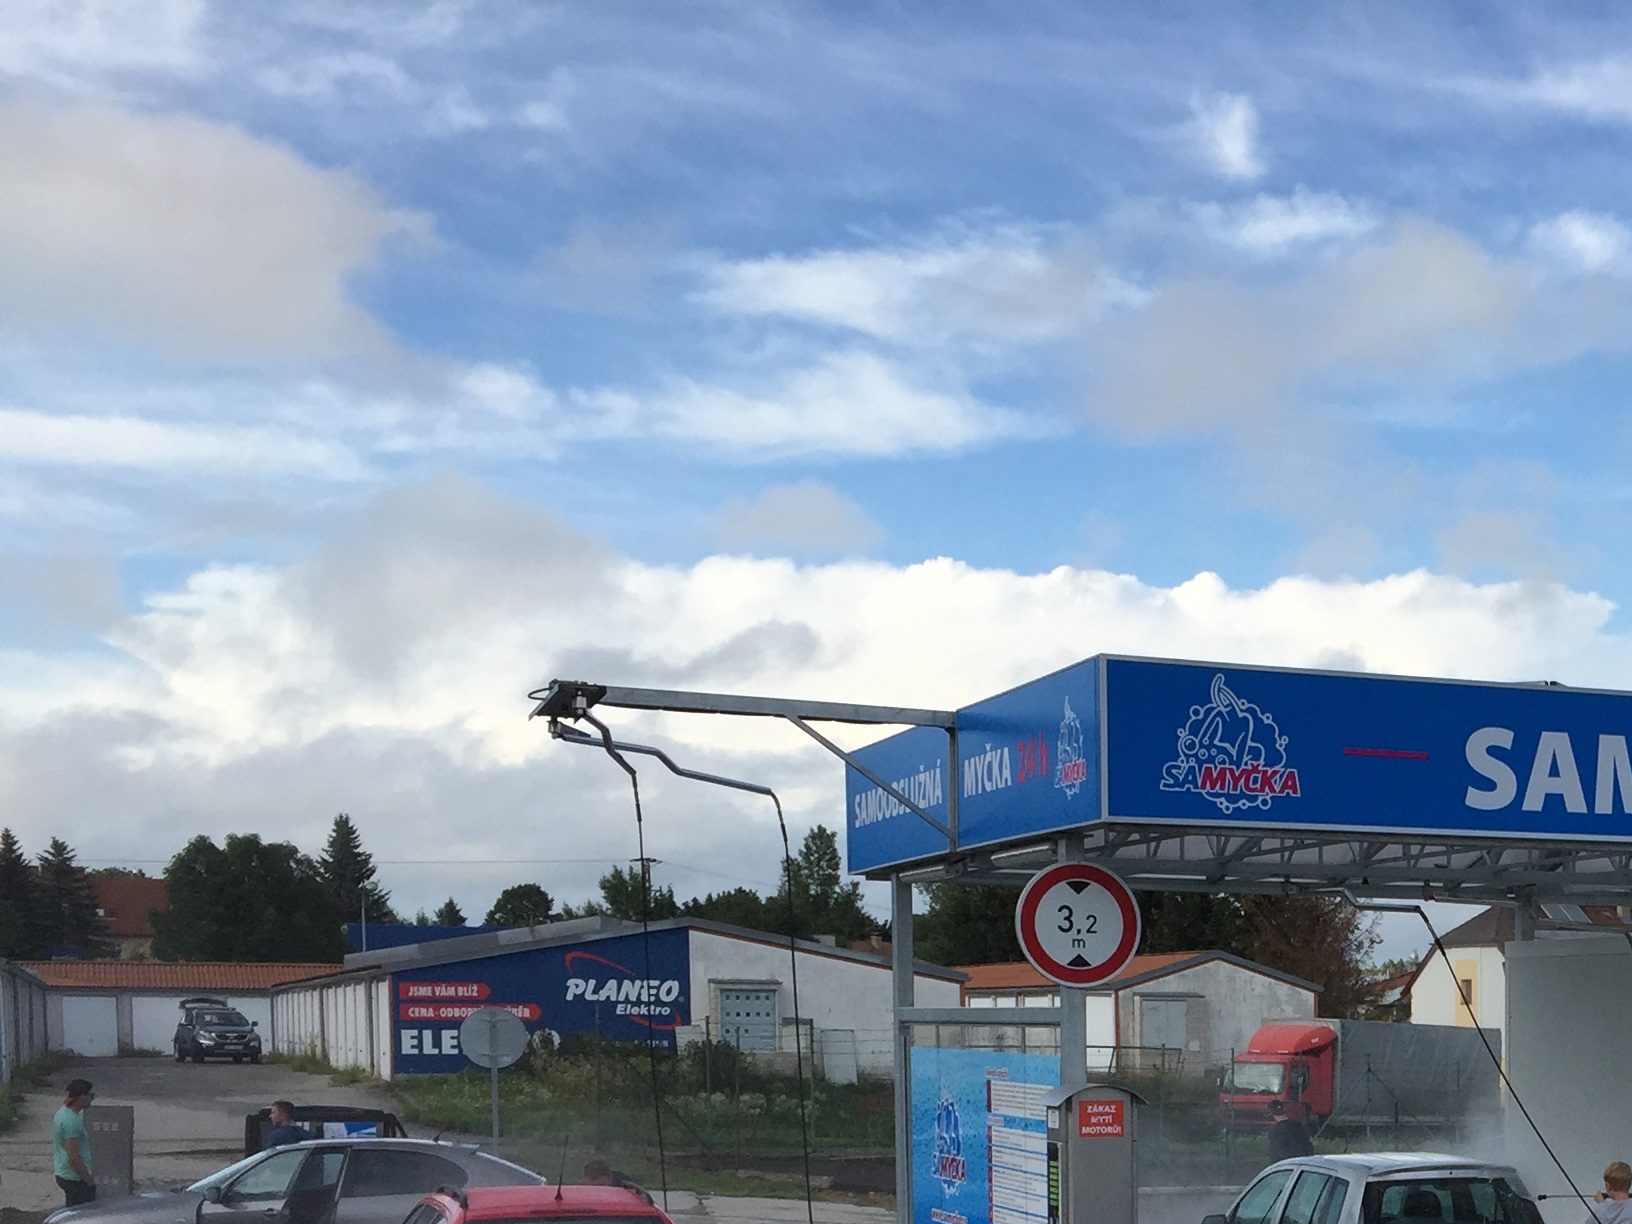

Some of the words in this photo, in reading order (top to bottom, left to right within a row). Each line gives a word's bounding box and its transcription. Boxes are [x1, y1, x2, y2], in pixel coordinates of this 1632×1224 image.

[854, 758, 943, 828] SAMOOBSLUŽNÁ
[963, 742, 1012, 798] MYČKA
[1016, 737, 1035, 783] 24
[1038, 731, 1049, 777] h
[1160, 761, 1301, 797] SAMYČKA
[1057, 904, 1098, 936] 3,2
[1071, 938, 1086, 948] m
[434, 983, 456, 996] VÁM
[566, 978, 680, 1001] PLANEO
[408, 1007, 434, 1018] CENA
[616, 1003, 671, 1015] Elektro
[1086, 1104, 1116, 1113] ZÁKAZ
[1090, 1114, 1113, 1124] MYTÍ
[1081, 1123, 1122, 1135] MOTORŮ!
